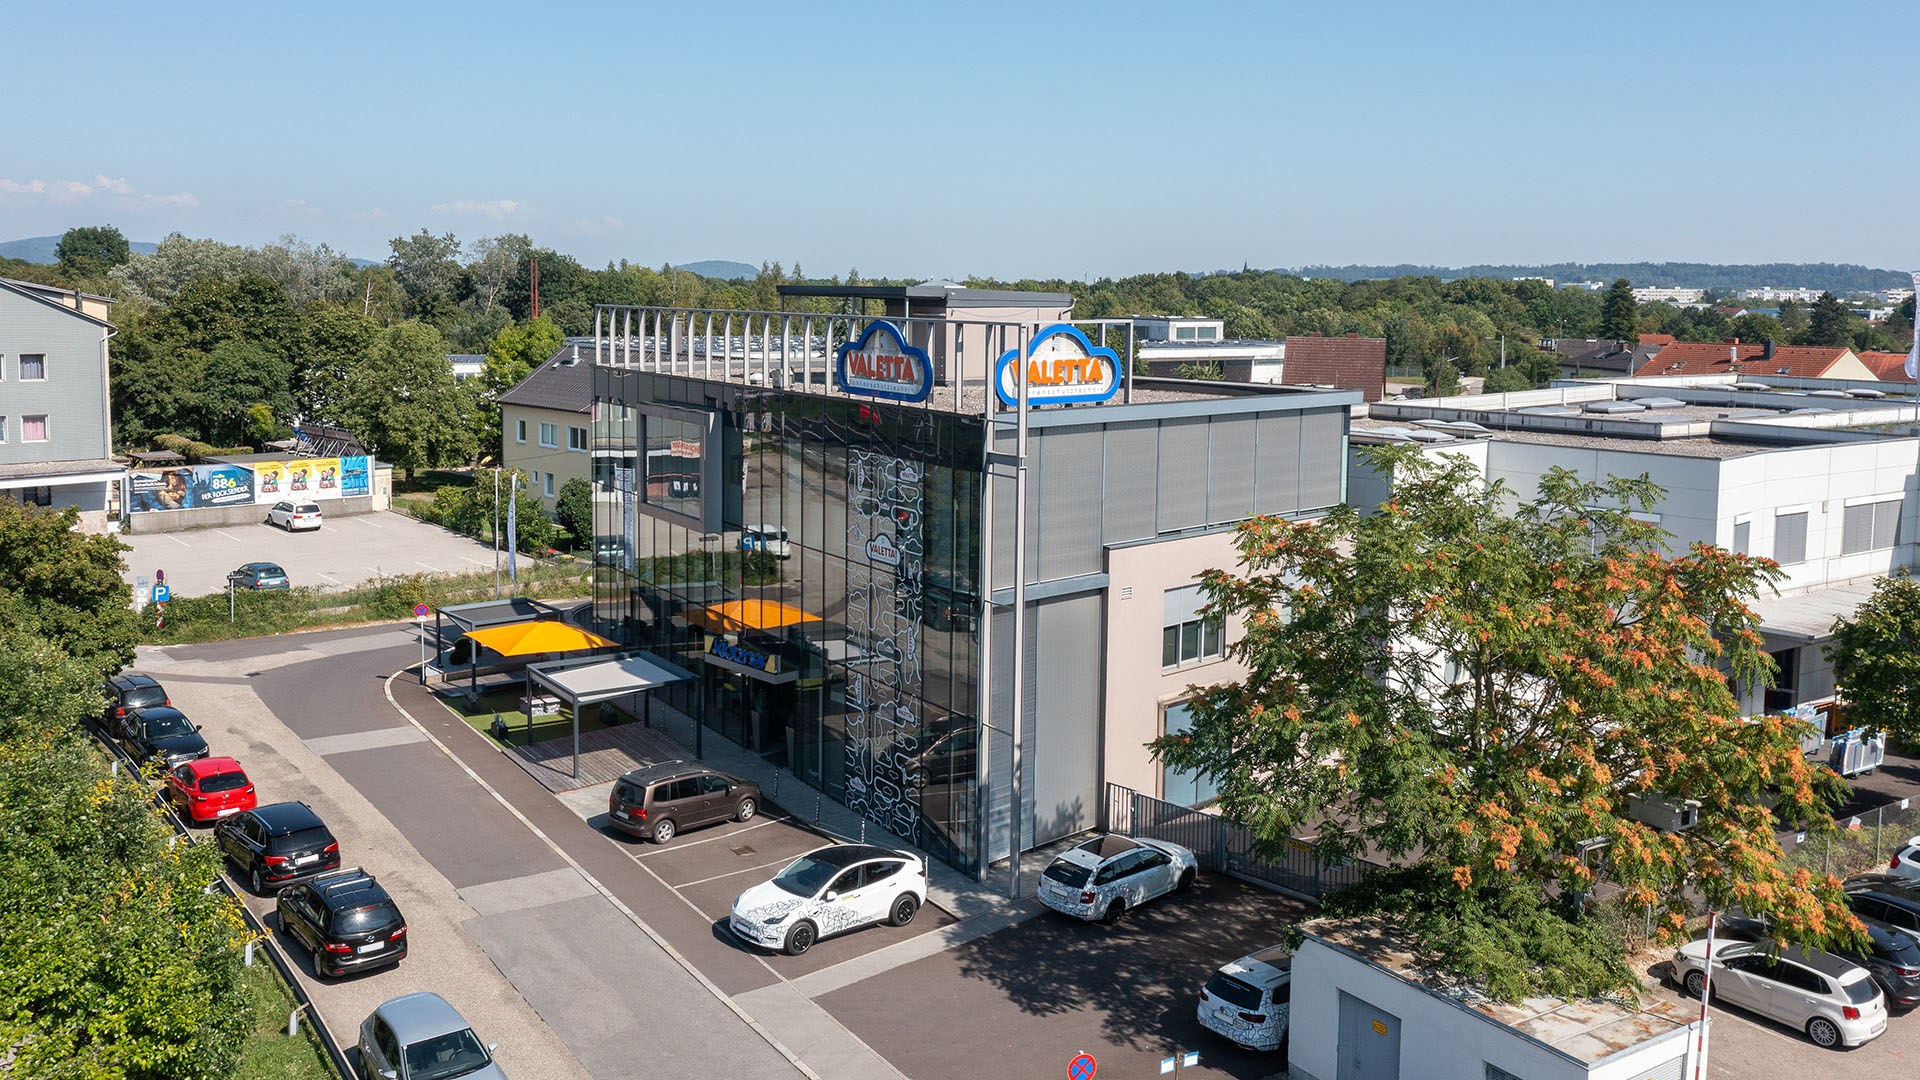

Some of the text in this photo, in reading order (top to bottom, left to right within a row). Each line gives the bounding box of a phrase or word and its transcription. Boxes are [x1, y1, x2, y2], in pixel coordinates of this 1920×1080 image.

[848, 351, 914, 382] VALETTA
[870, 543, 896, 559] VALETTA
[155, 587, 166, 600] P
